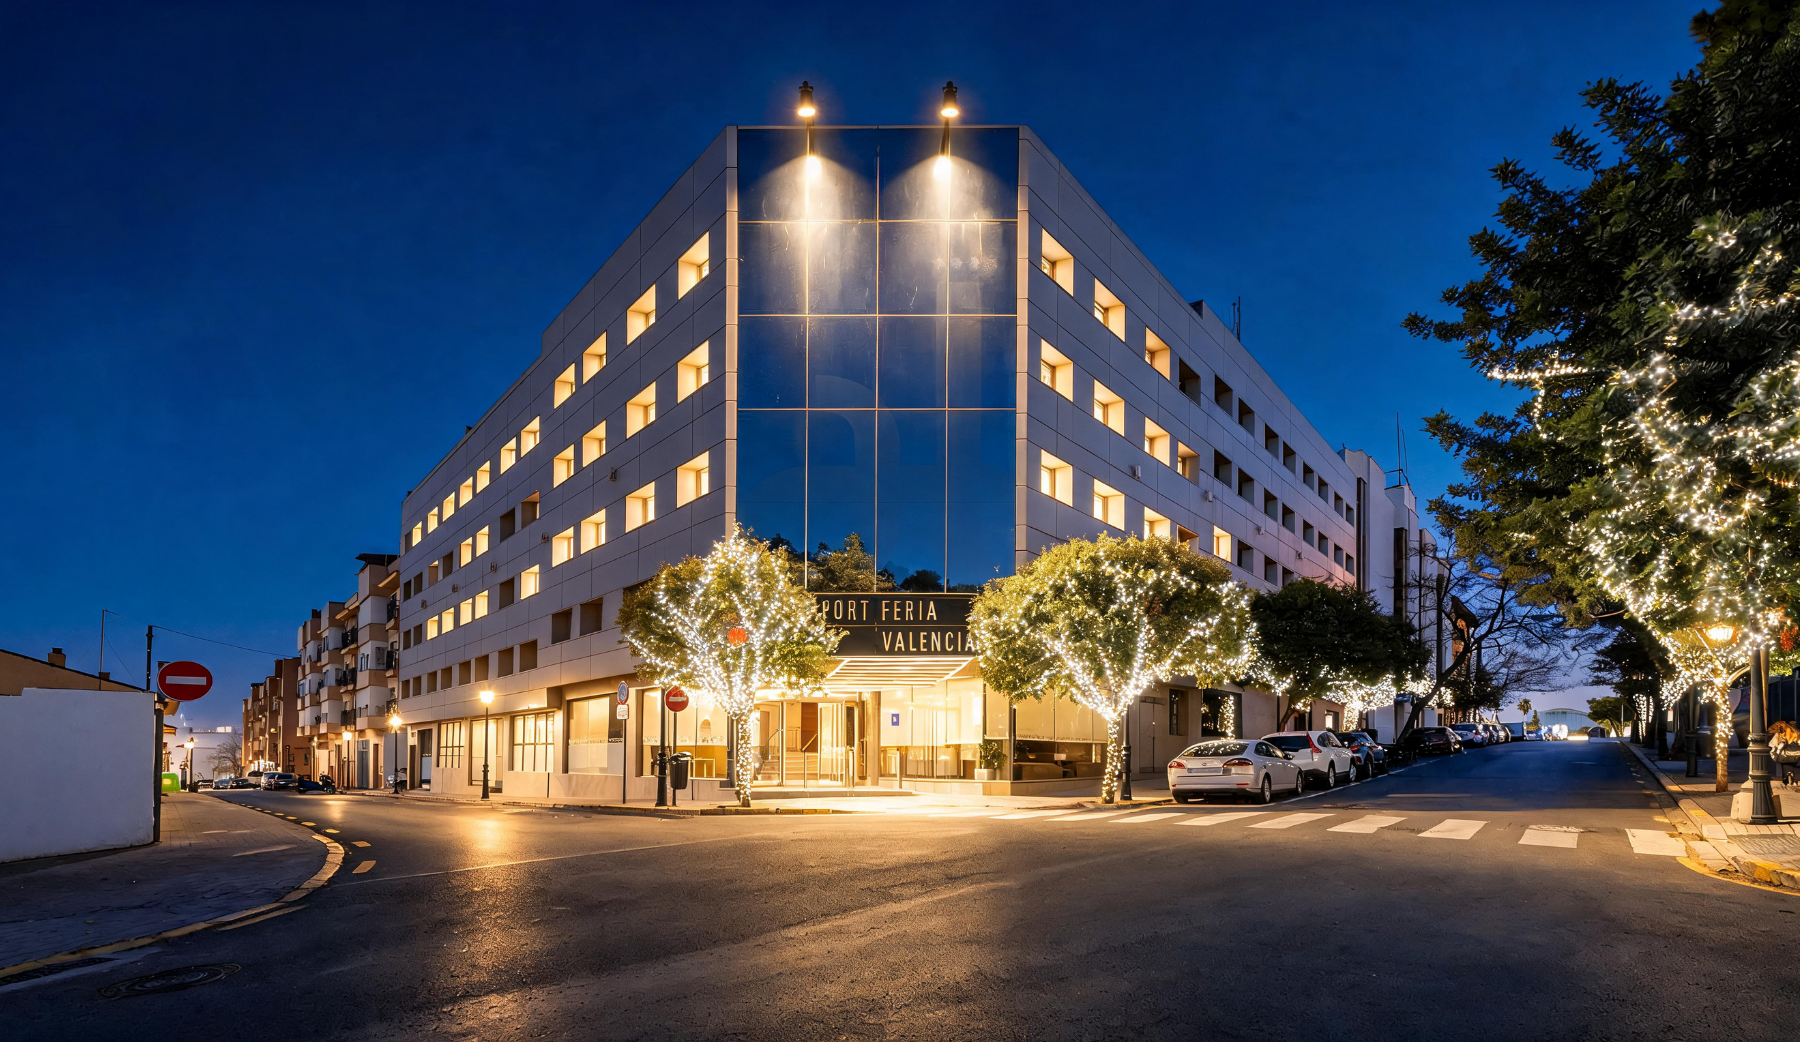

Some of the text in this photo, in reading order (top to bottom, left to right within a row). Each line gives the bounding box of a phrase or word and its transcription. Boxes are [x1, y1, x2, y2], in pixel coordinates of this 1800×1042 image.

[822, 600, 937, 621] PORT FERIA
[882, 631, 974, 651] VALENCIA
